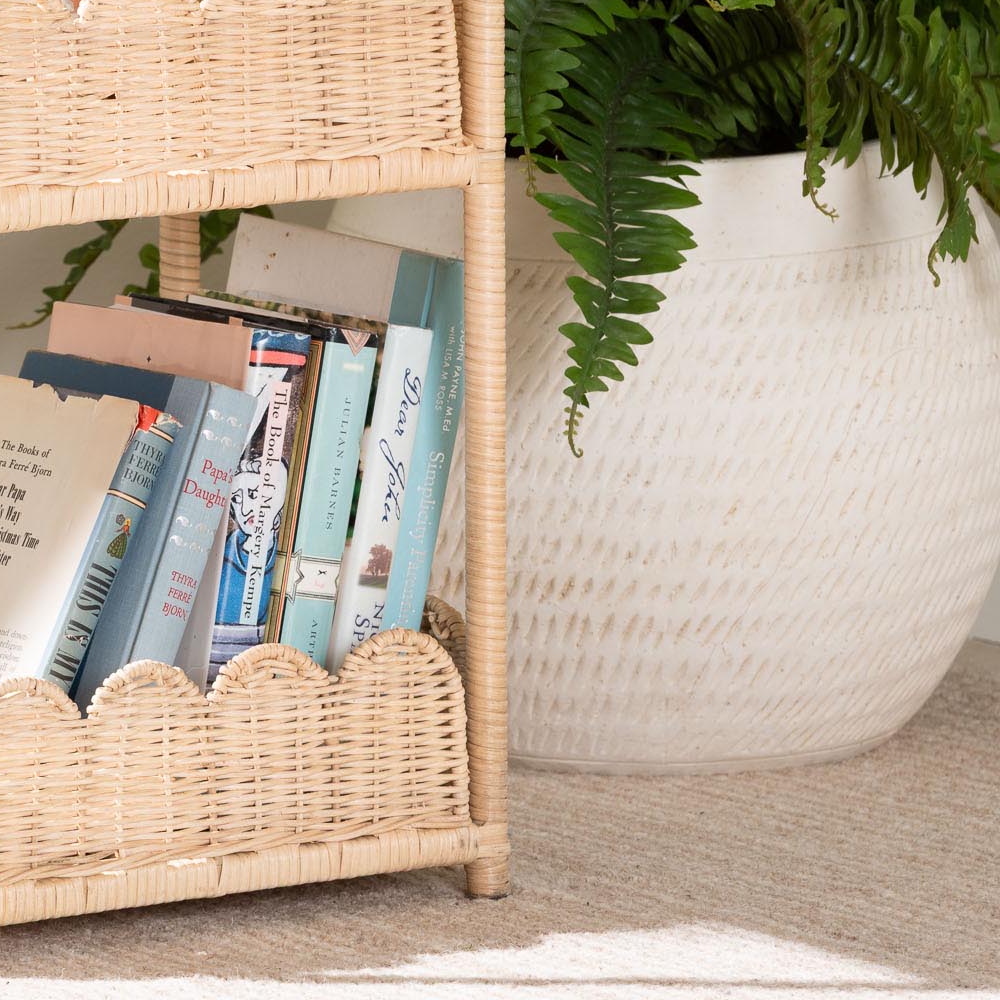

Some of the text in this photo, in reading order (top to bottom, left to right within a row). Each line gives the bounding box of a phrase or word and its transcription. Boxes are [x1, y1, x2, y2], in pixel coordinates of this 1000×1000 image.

[447, 326, 456, 345] with
[442, 348, 454, 369] LISA
[435, 385, 446, 411] ROSS
[0, 439, 52, 459] The Books of
[378, 367, 422, 522] Dear John
[8, 459, 30, 472] Ferré
[30, 464, 52, 477] Bjorn
[201, 458, 233, 485] Papa's
[327, 396, 352, 531] JULIAN BARNES
[7, 483, 27, 503] Papa
[183, 478, 228, 509] Daught
[243, 389, 288, 619] The Book of Margery Kempe
[409, 451, 444, 539] Simplicity
[6, 504, 22, 526] Way
[21, 532, 40, 550] Time
[75, 562, 119, 618] THIS
[168, 587, 193, 605] FERRÉ
[162, 602, 188, 622] BJORN
